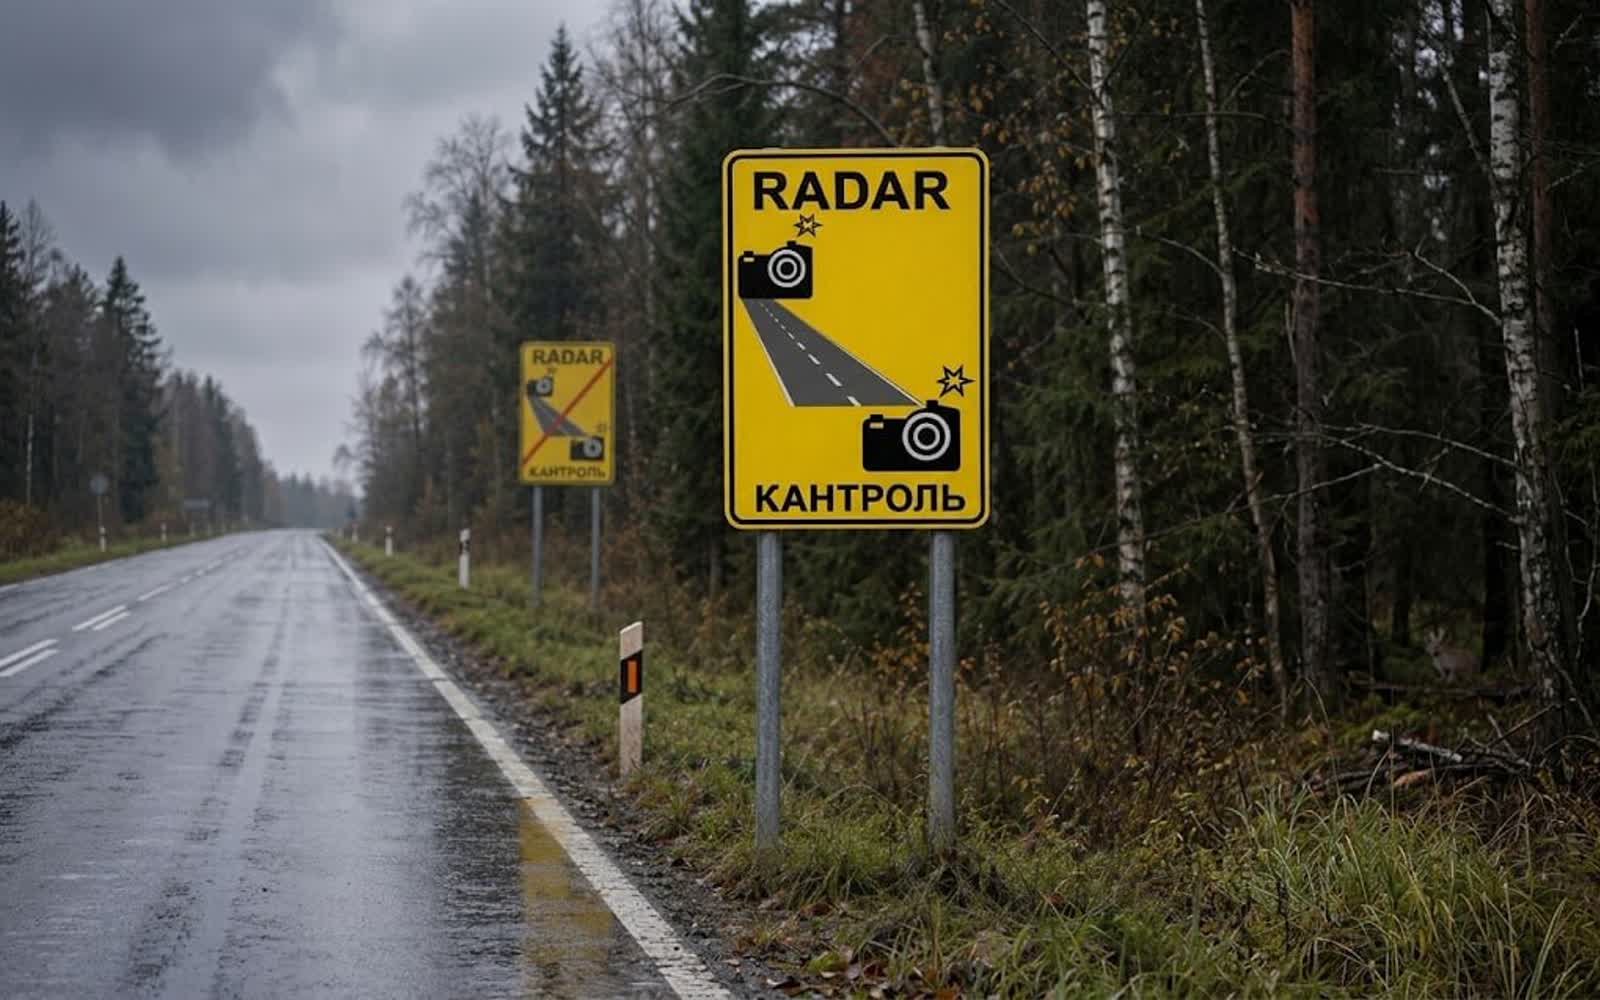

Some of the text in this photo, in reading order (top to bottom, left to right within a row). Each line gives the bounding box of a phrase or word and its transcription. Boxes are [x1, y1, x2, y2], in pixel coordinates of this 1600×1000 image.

[753, 171, 951, 210] RADAR
[533, 349, 603, 364] RADAR
[755, 484, 965, 513] КАНТРОЛЬ
